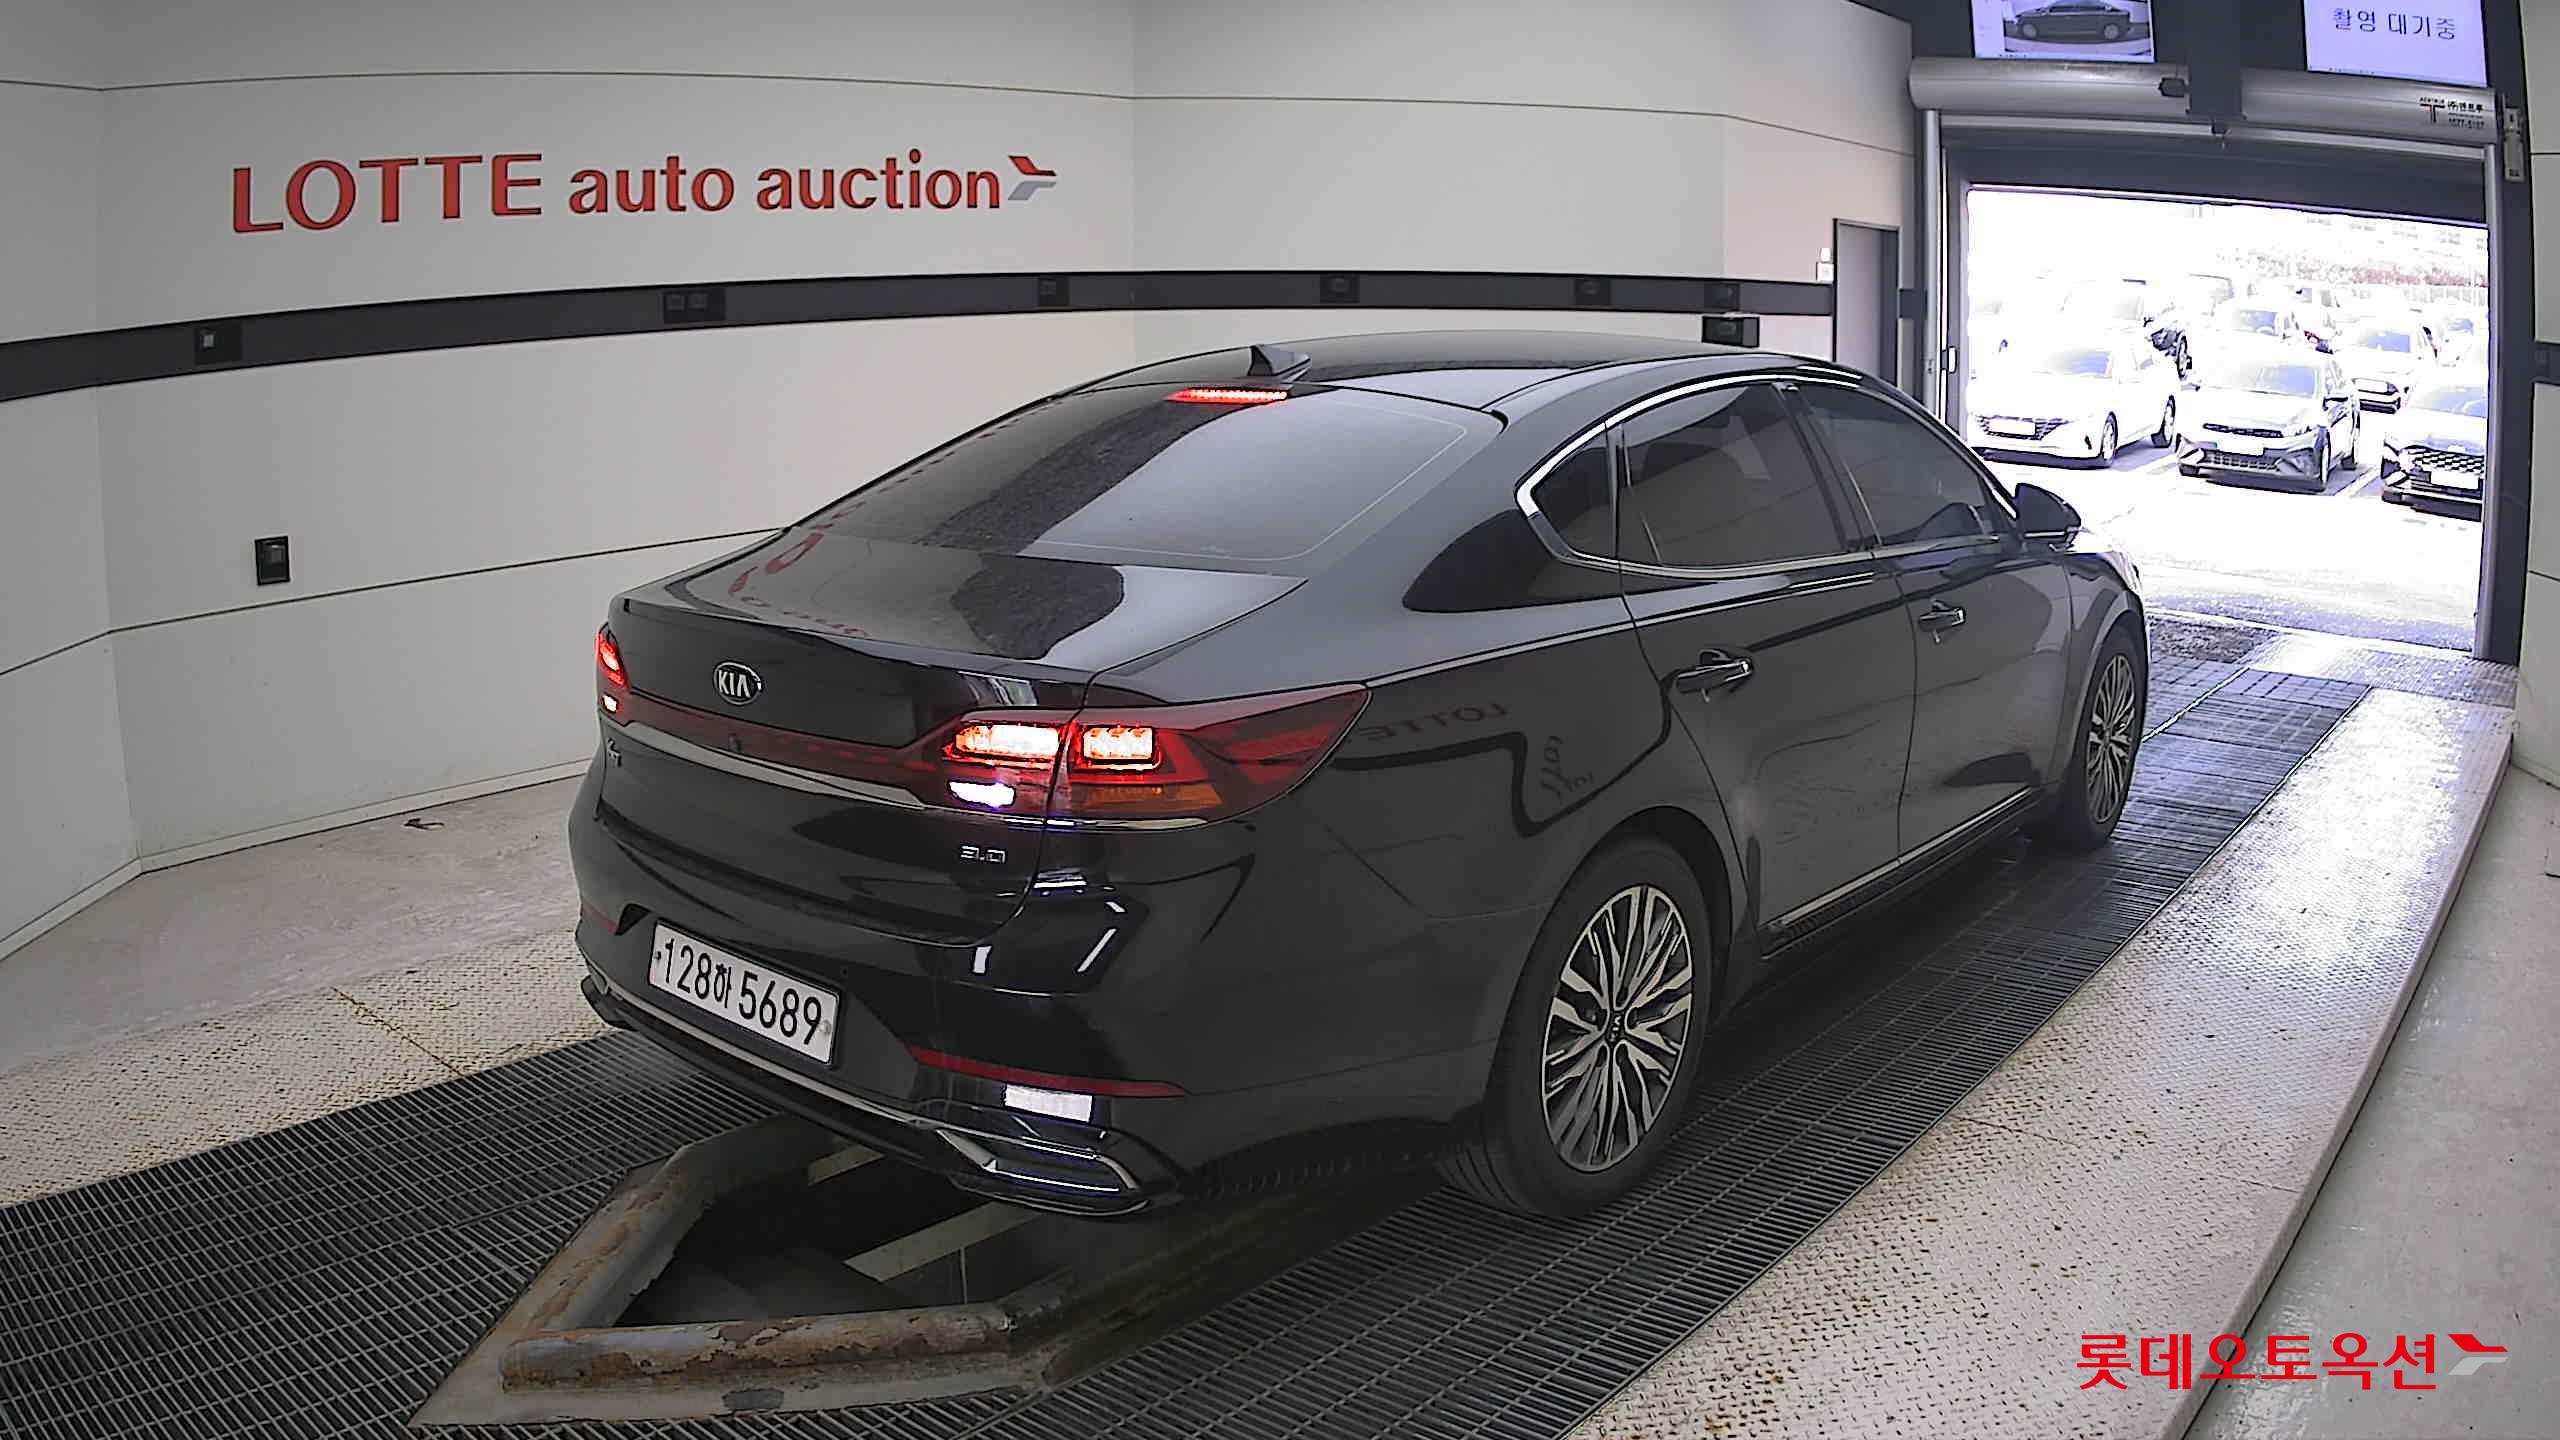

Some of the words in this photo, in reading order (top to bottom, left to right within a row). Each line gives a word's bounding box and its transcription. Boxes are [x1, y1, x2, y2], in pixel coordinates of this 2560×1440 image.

[2333, 8, 2376, 33] 촬영
[2388, 12, 2456, 40] 대기중
[232, 153, 542, 234] LOTTE
[569, 157, 734, 213] auto
[757, 150, 1002, 210] auction
[718, 669, 751, 698] KIA
[960, 845, 1006, 864] 3.0
